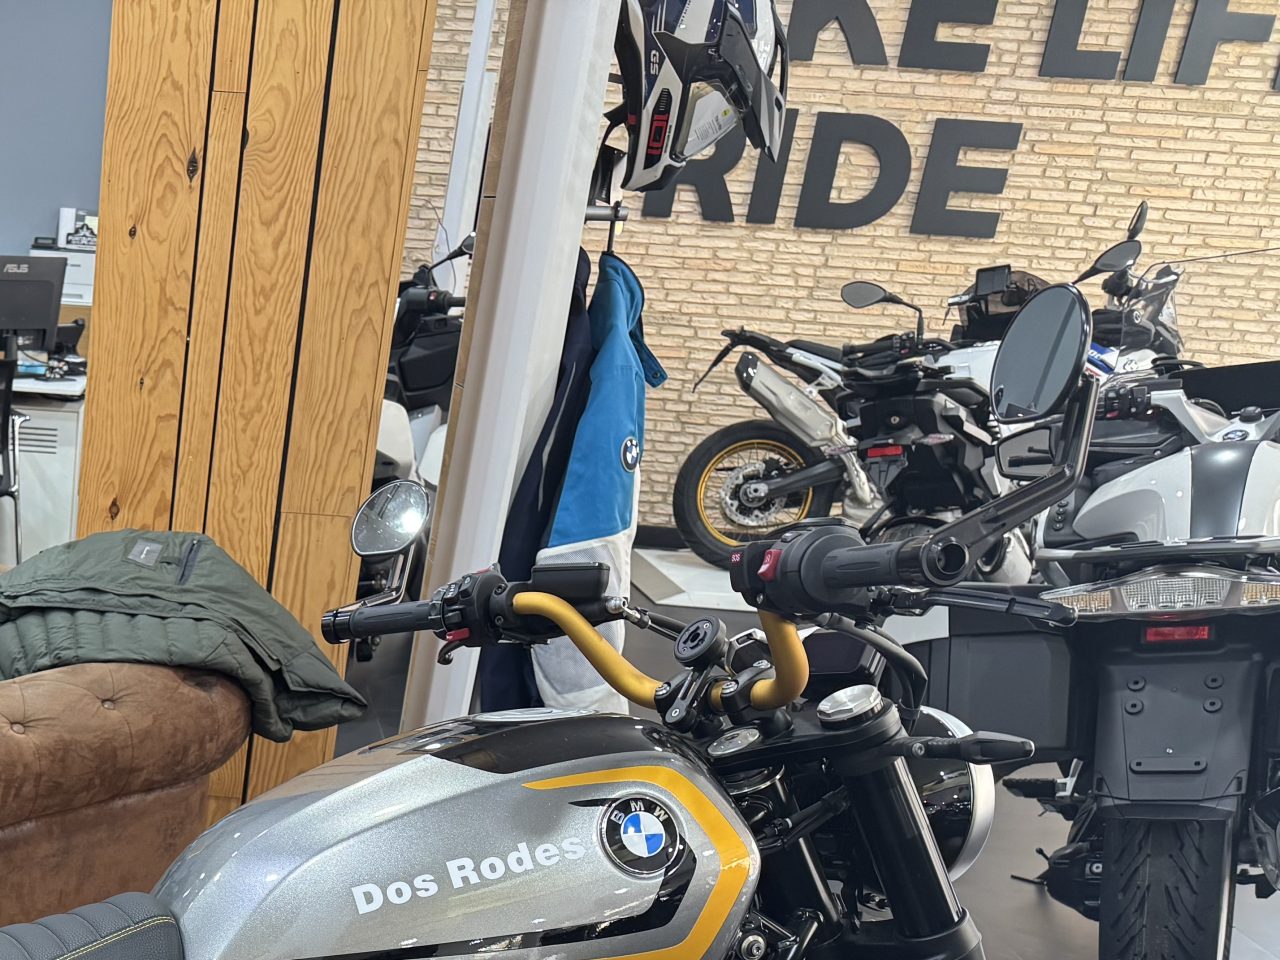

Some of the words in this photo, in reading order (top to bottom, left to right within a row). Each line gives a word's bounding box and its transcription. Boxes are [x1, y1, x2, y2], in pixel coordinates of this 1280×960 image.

[787, 0, 1000, 73] KE
[1037, 0, 1280, 91] LIF
[3, 263, 30, 274] ASUS
[351, 872, 439, 915] Dos
[445, 835, 587, 889] Rodes
